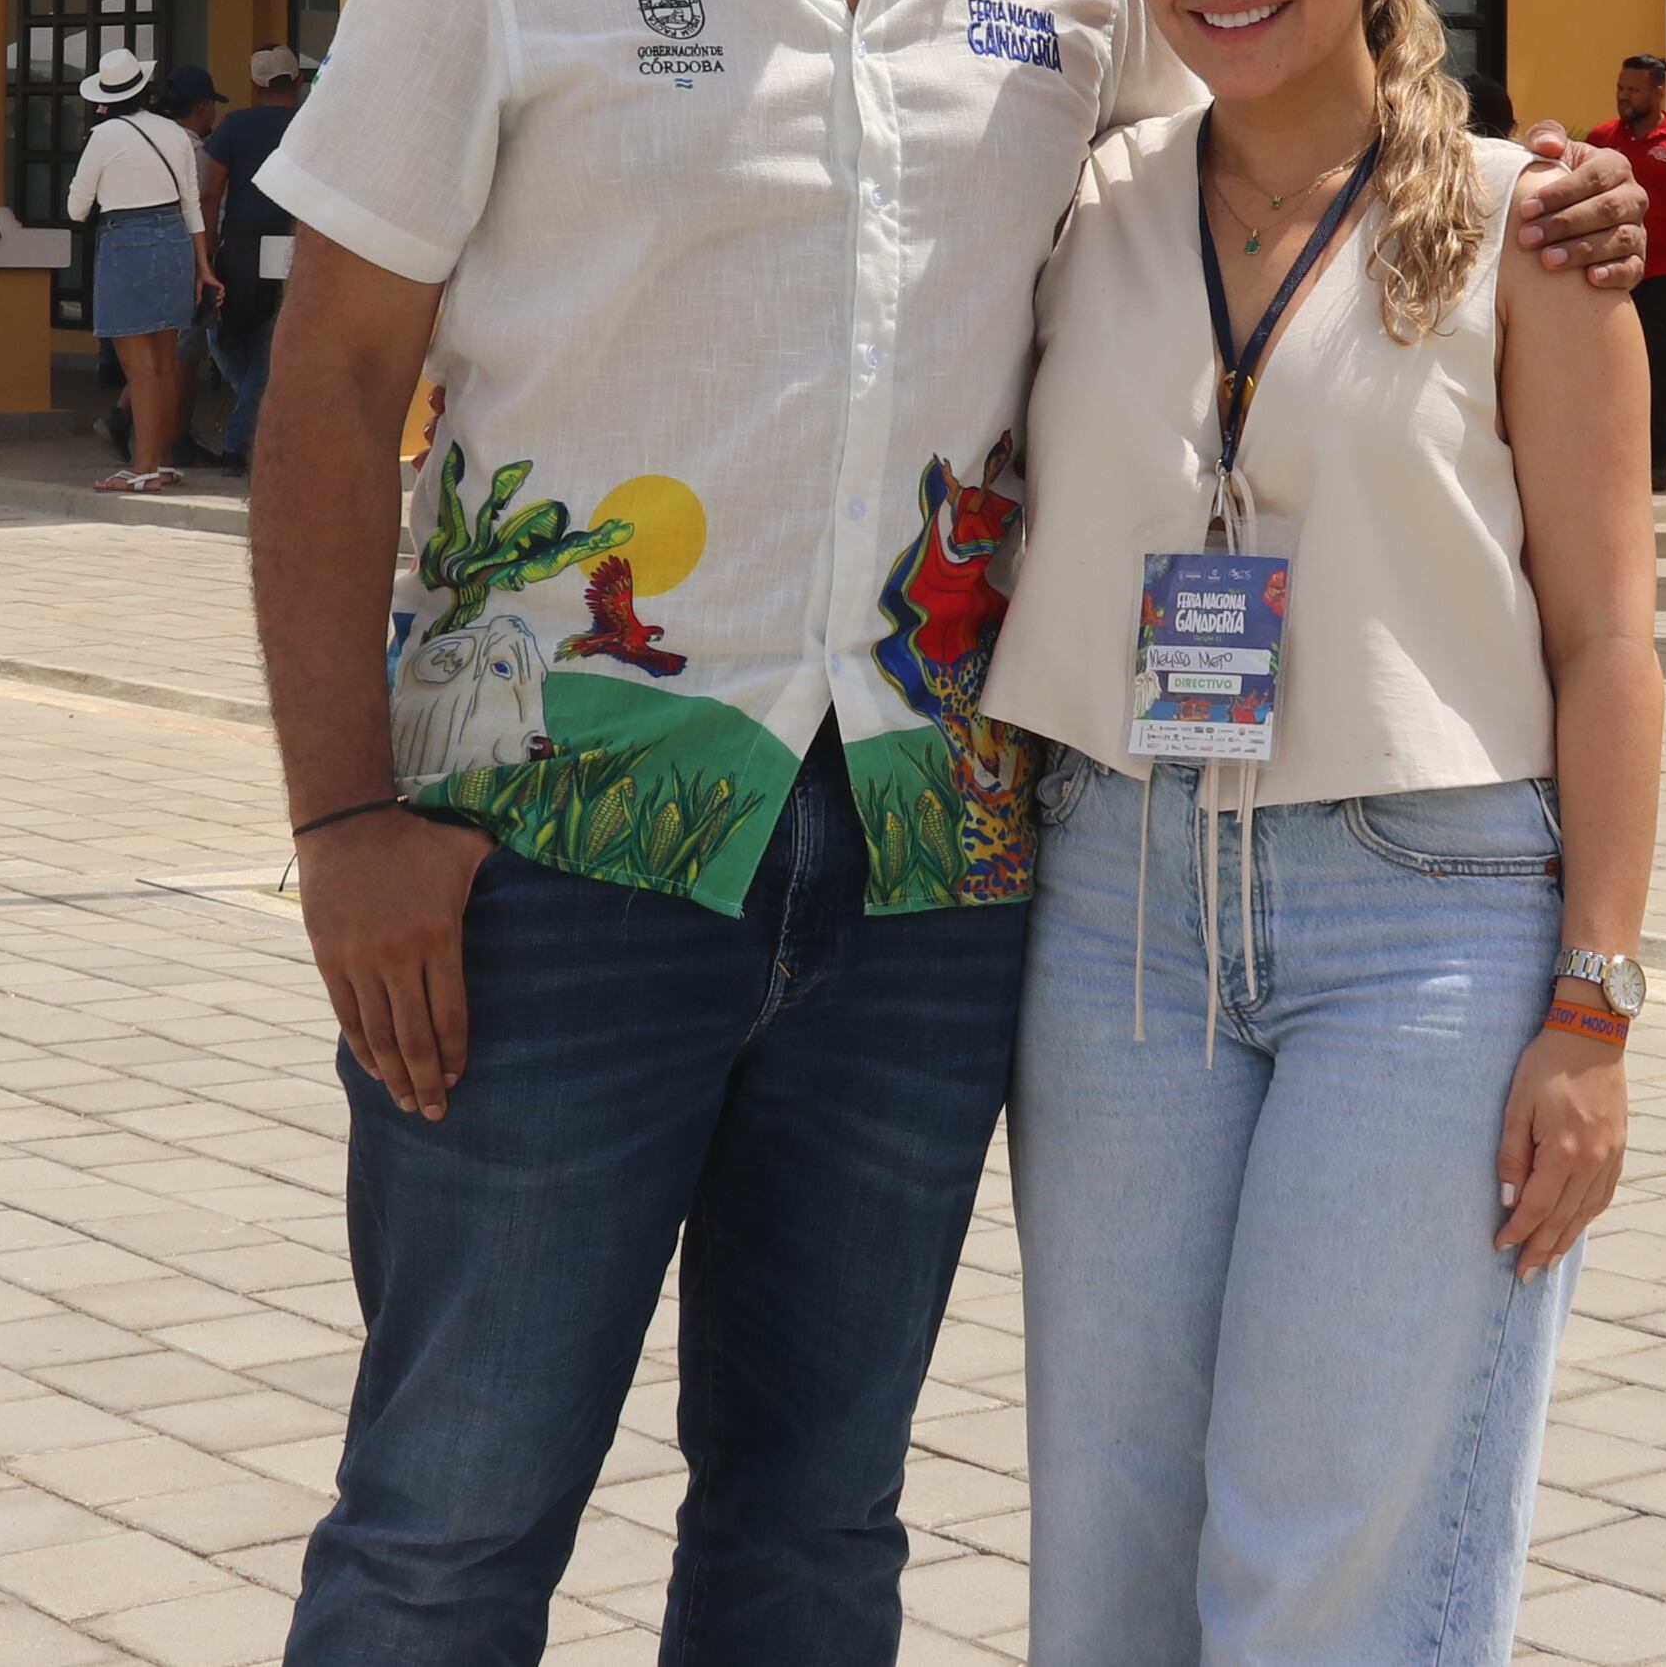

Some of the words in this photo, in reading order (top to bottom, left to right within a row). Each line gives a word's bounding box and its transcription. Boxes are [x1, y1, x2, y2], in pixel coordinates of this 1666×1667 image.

[639, 57, 724, 74] CÓRDOBA
[1176, 591, 1202, 609] FERIA
[1202, 592, 1247, 611] NACIONAL
[1174, 609, 1245, 634] GANADERÍA
[1174, 678, 1233, 689] DIRECTIVO
